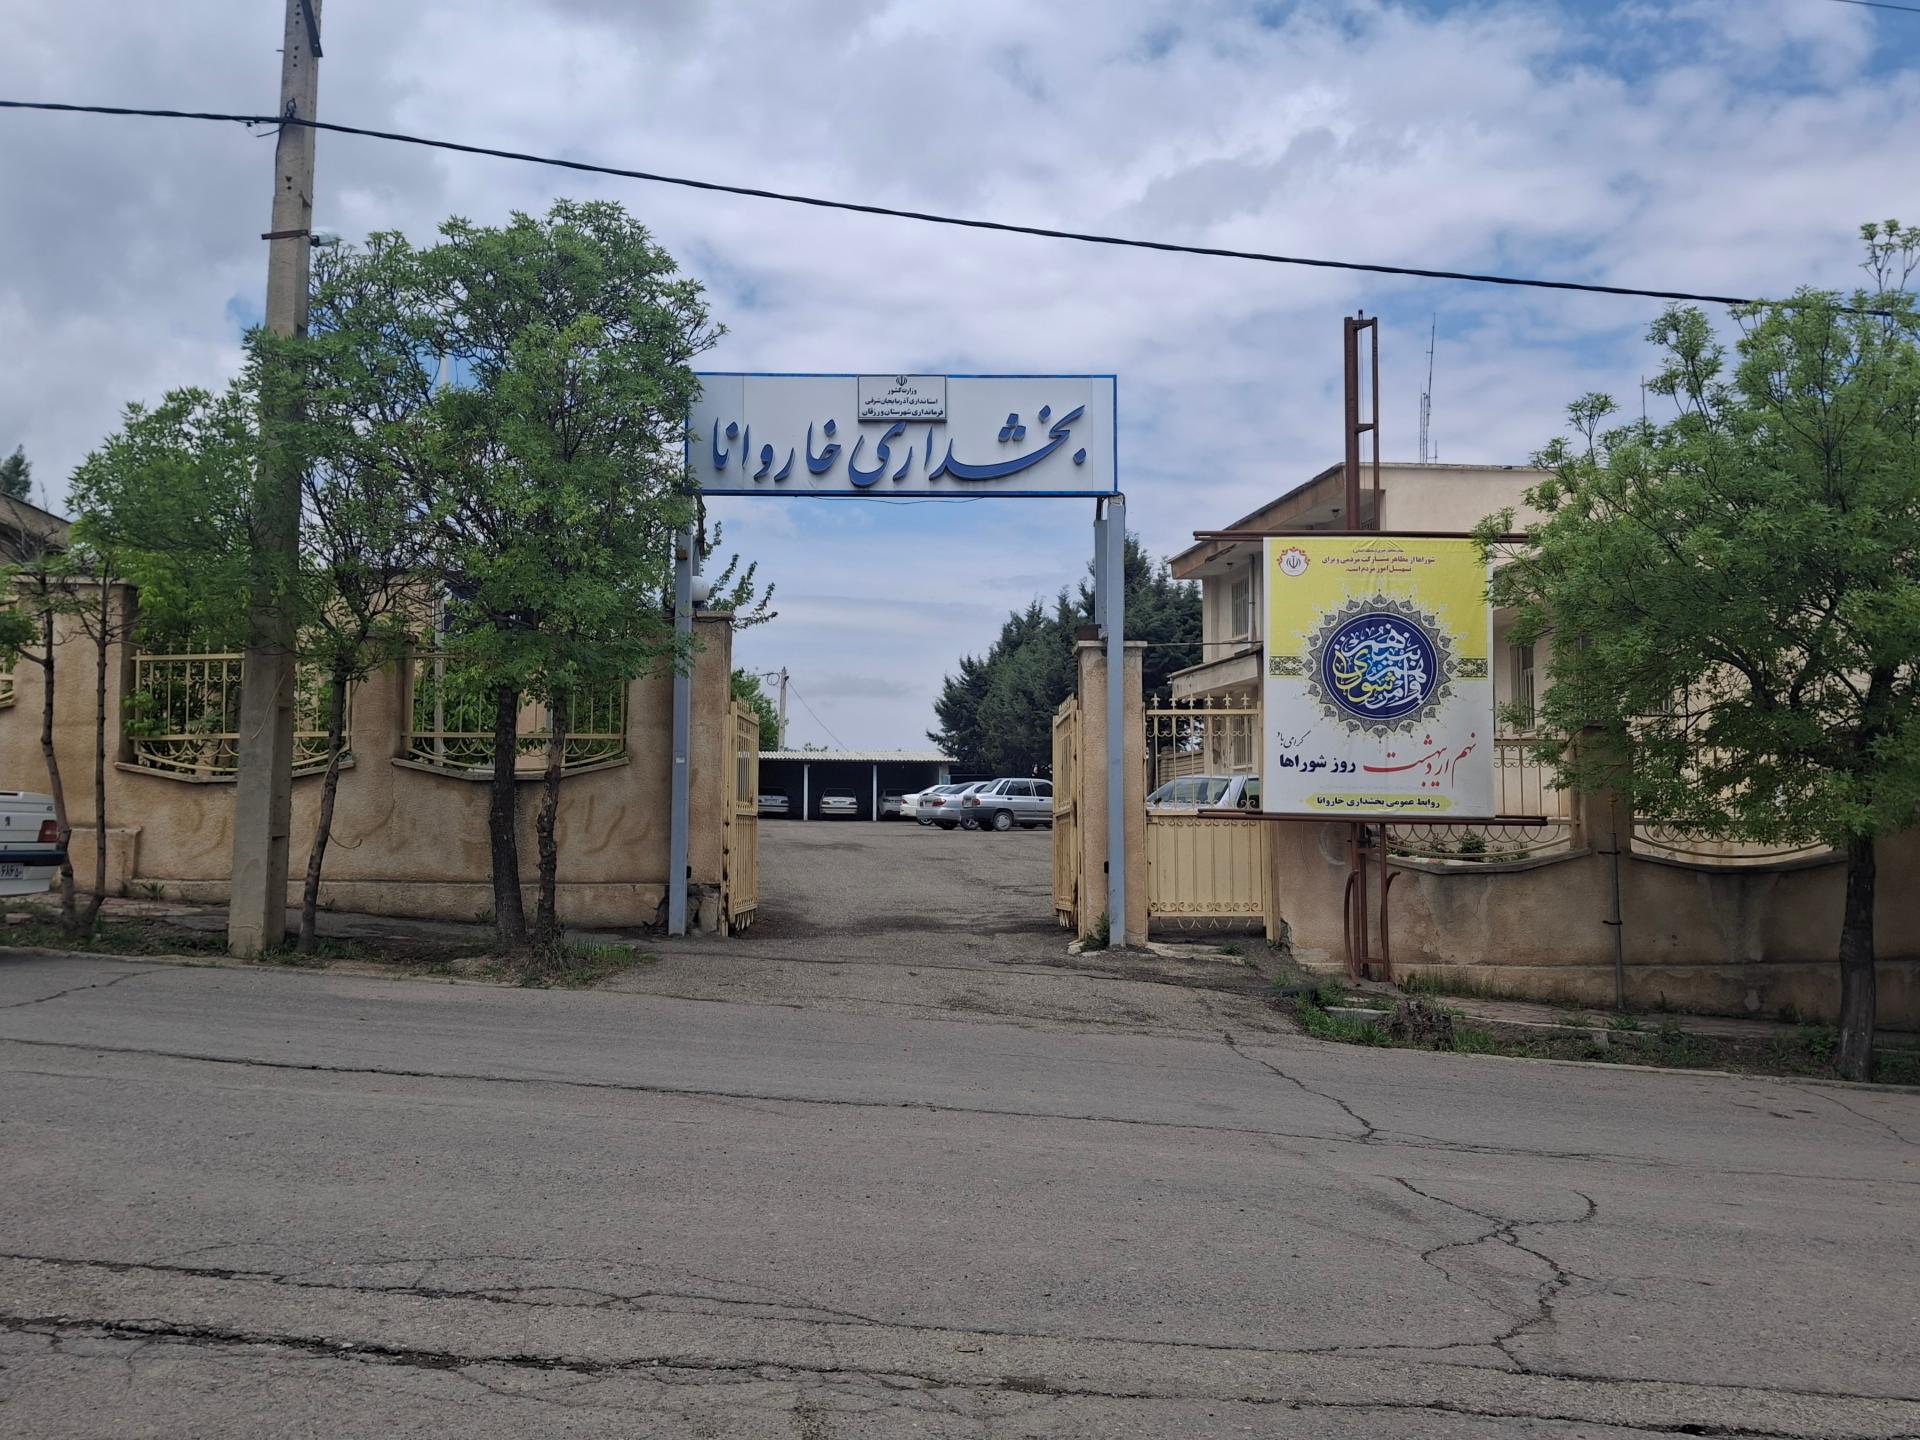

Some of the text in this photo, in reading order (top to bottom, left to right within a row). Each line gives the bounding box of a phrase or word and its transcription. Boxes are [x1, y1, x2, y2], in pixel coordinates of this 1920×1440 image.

[888, 387, 917, 395] وزارت کشور
[880, 397, 909, 405] آذربایجان
[909, 397, 938, 405] استانداری
[885, 408, 912, 416] شهرستان
[912, 408, 944, 417] فرمانداری
[711, 403, 1088, 489] بخشداری خاروانا
[1279, 753, 1327, 773] شوراها
[1451, 732, 1477, 789] نهم
[1330, 759, 1357, 773] روز
[1316, 796, 1345, 807] خاروانا
[1347, 797, 1385, 807] بخشداری
[1416, 798, 1440, 809] روابط
